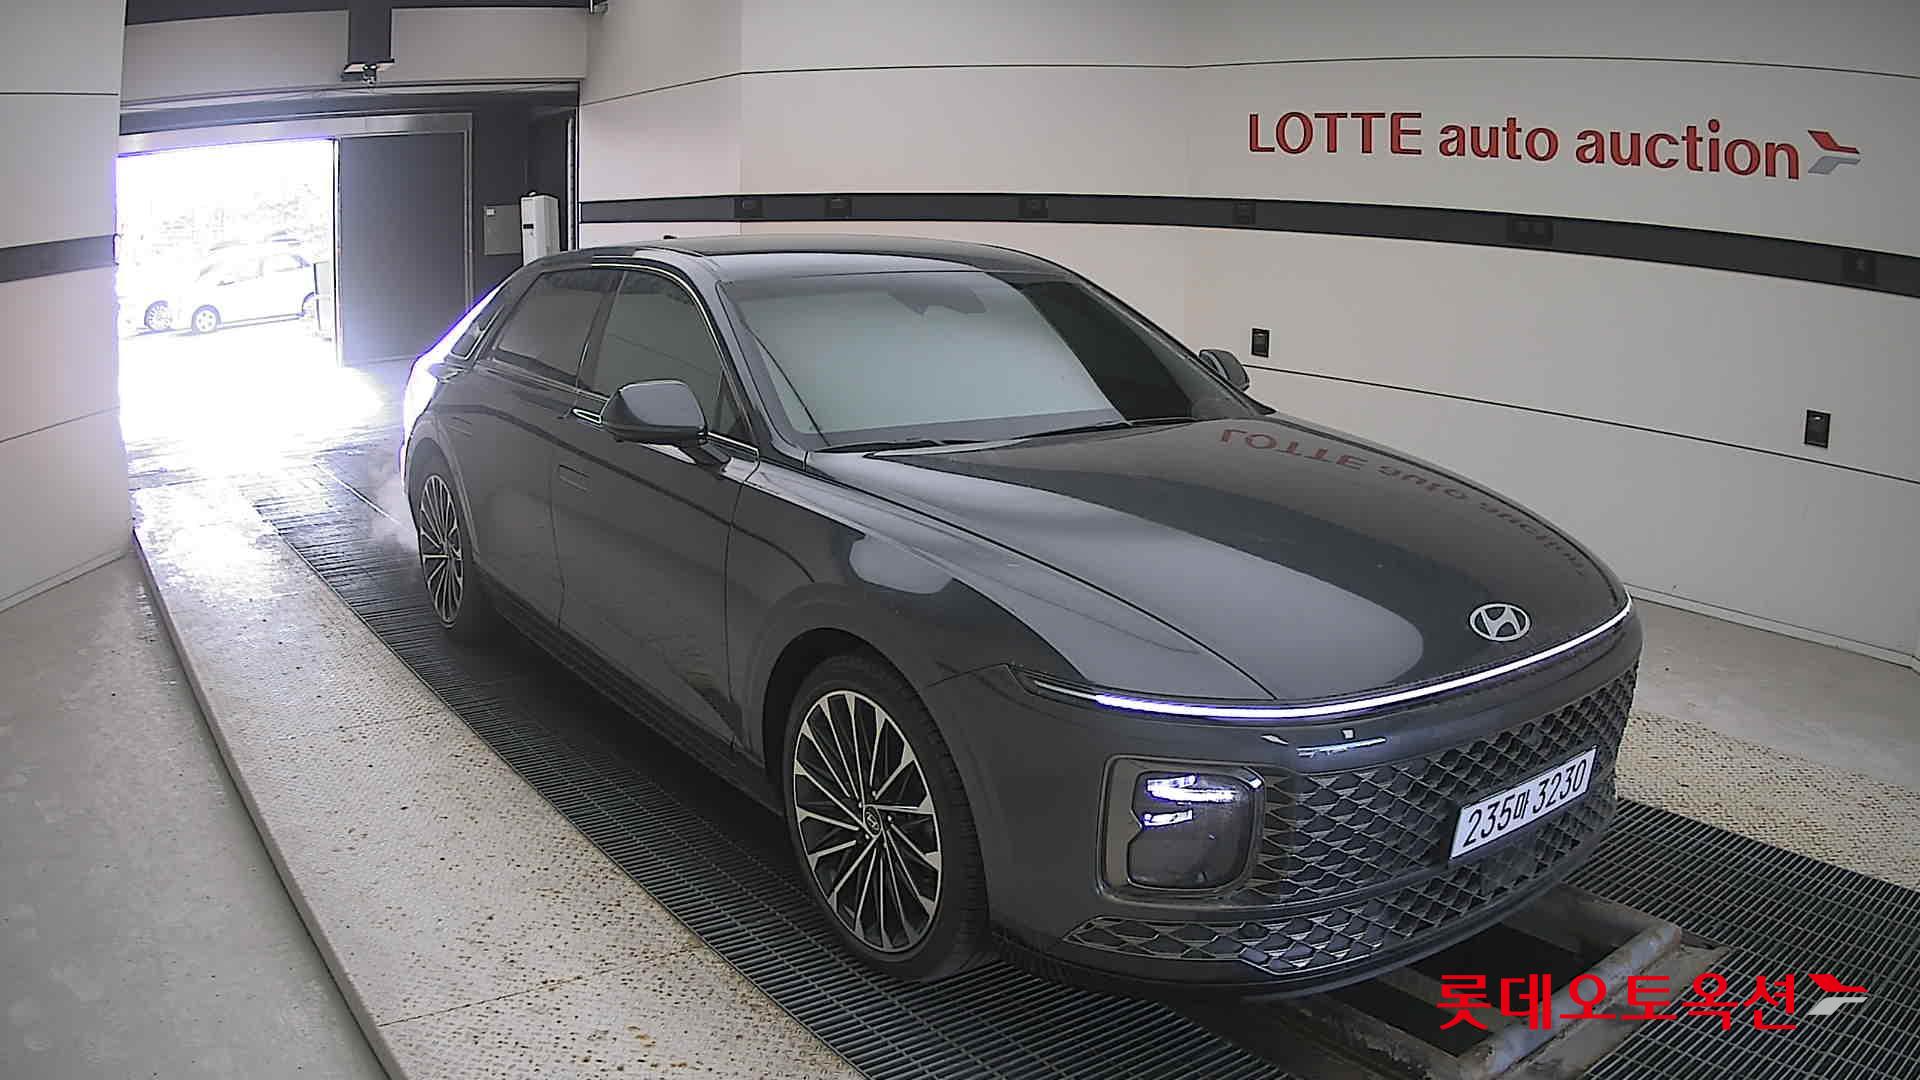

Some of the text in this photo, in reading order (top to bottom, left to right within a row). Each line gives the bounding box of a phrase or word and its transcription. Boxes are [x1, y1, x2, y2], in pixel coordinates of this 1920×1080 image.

[1248, 112, 1800, 180] LOTTE auto auction
[1462, 758, 1588, 848] 235마 3230
